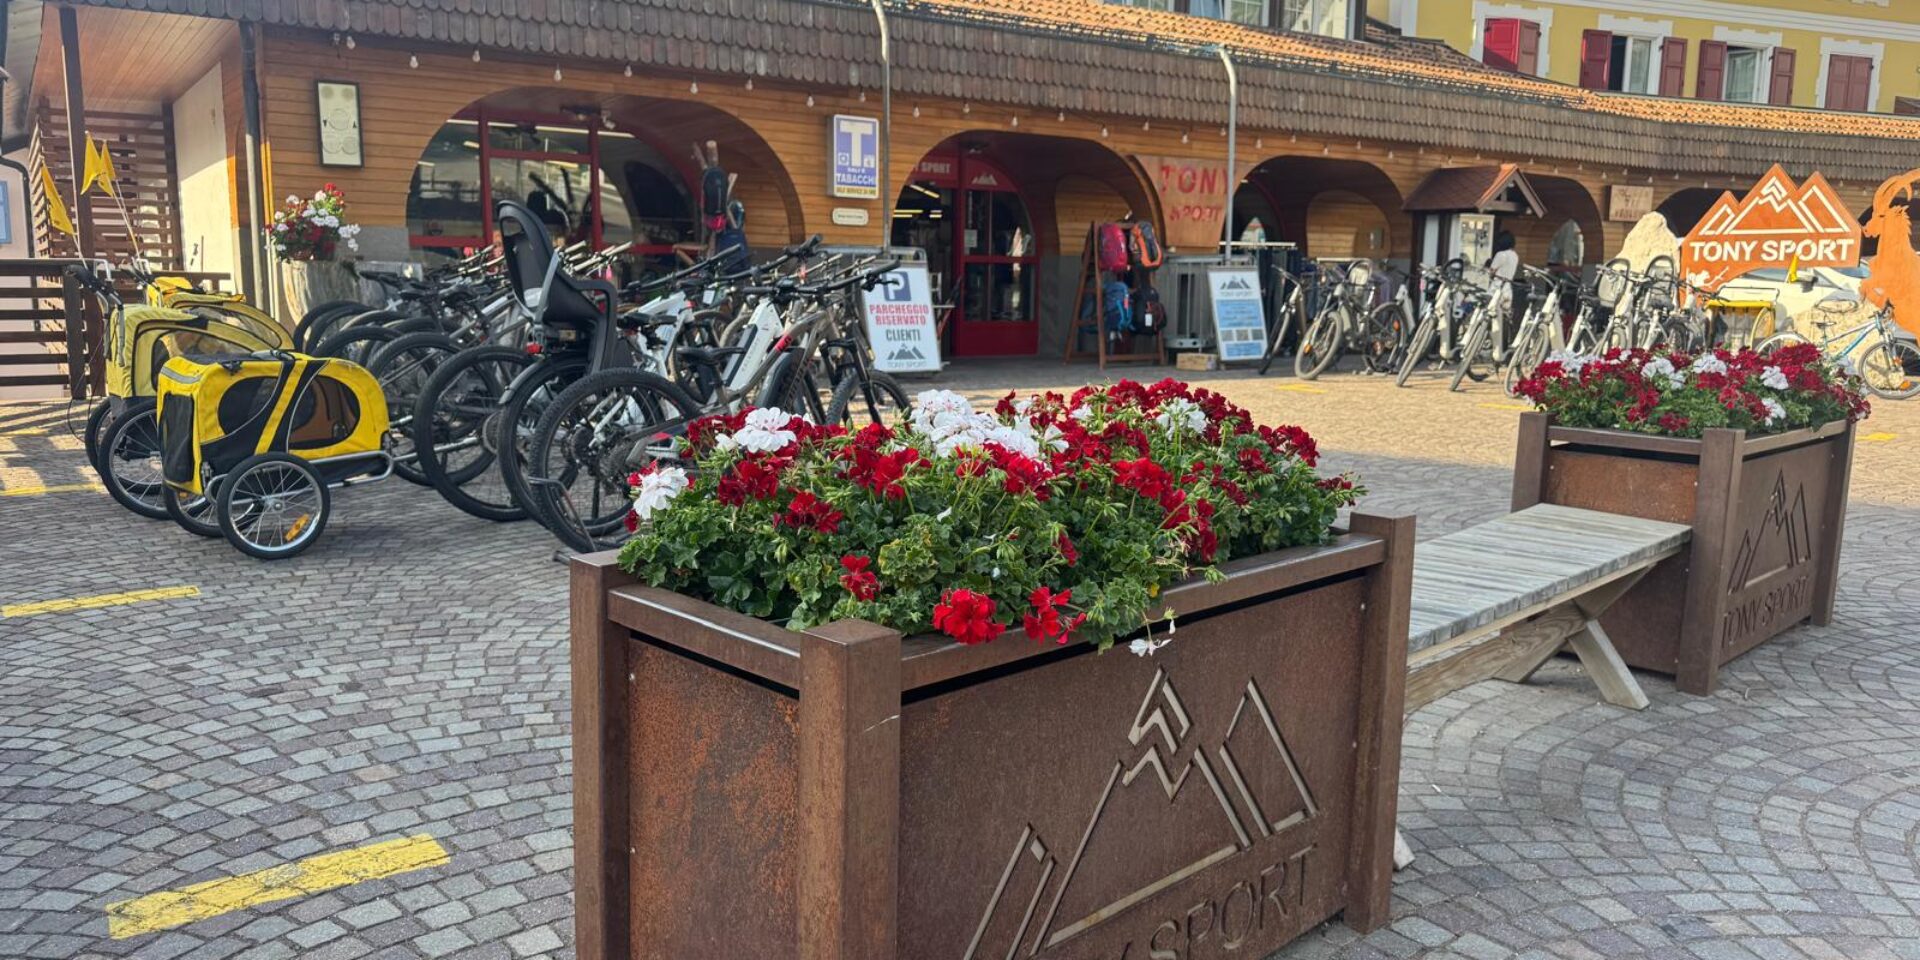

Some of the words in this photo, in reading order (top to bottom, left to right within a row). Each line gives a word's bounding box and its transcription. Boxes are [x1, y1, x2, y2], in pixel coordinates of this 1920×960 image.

[840, 120, 873, 167] T
[921, 162, 951, 174] SPORT
[1689, 240, 1758, 262] TONY
[1760, 238, 1854, 262] SPORT
[869, 304, 929, 314] PARCHEGGIO
[875, 315, 926, 326] RISERVATO
[885, 329, 921, 341] CLIENTI
[1722, 597, 1762, 649] TONY
[1761, 576, 1808, 626] SPORT
[1150, 843, 1316, 960] SPORT
